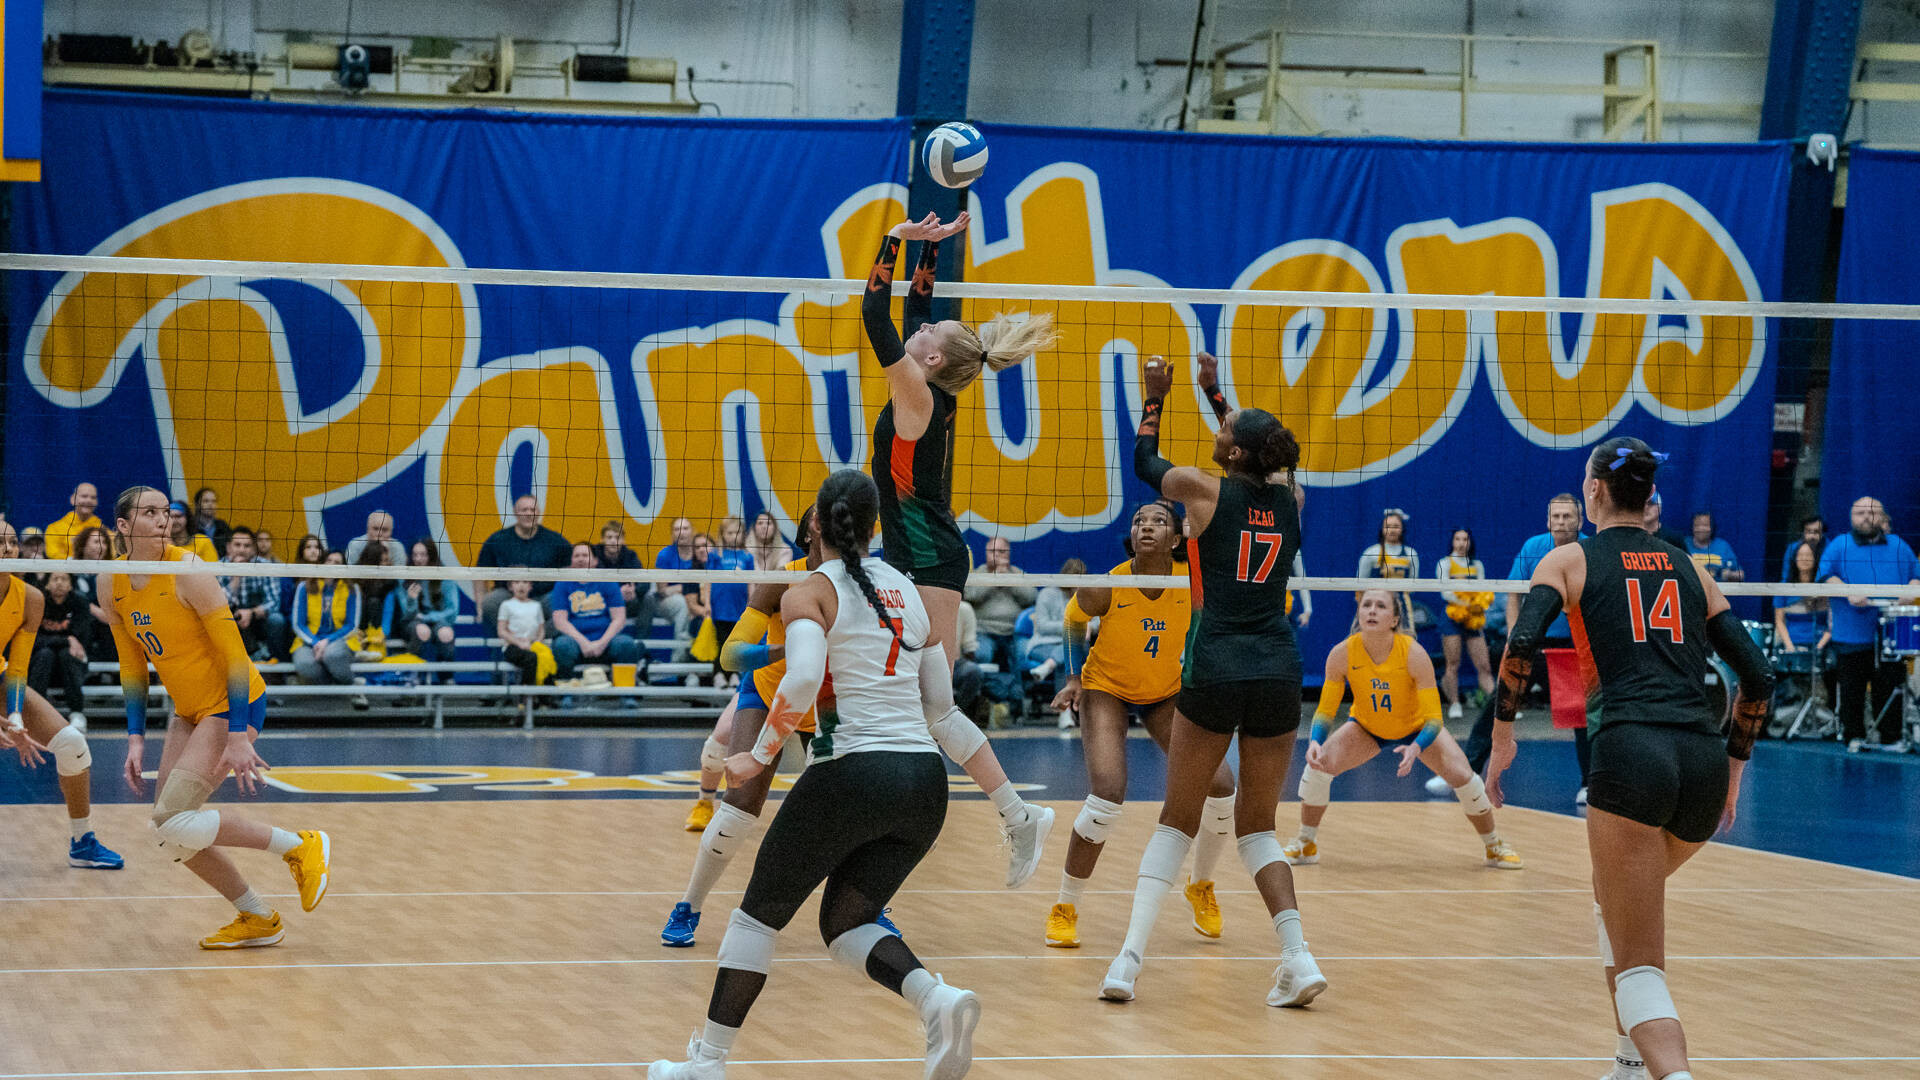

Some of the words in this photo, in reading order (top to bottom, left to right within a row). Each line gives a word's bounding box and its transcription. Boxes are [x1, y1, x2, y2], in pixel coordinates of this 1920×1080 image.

[24, 162, 1767, 590] Panthers
[1248, 507, 1275, 527] LEAO
[1236, 529, 1283, 583] 17
[1620, 551, 1674, 571] GRIEVE
[130, 611, 152, 626] Pitt
[1625, 578, 1684, 644] 14
[1140, 617, 1167, 631] Pitt
[136, 630, 164, 662] 10
[878, 617, 904, 676] 7
[1143, 635, 1160, 659] 4
[1370, 693, 1392, 713] 14
